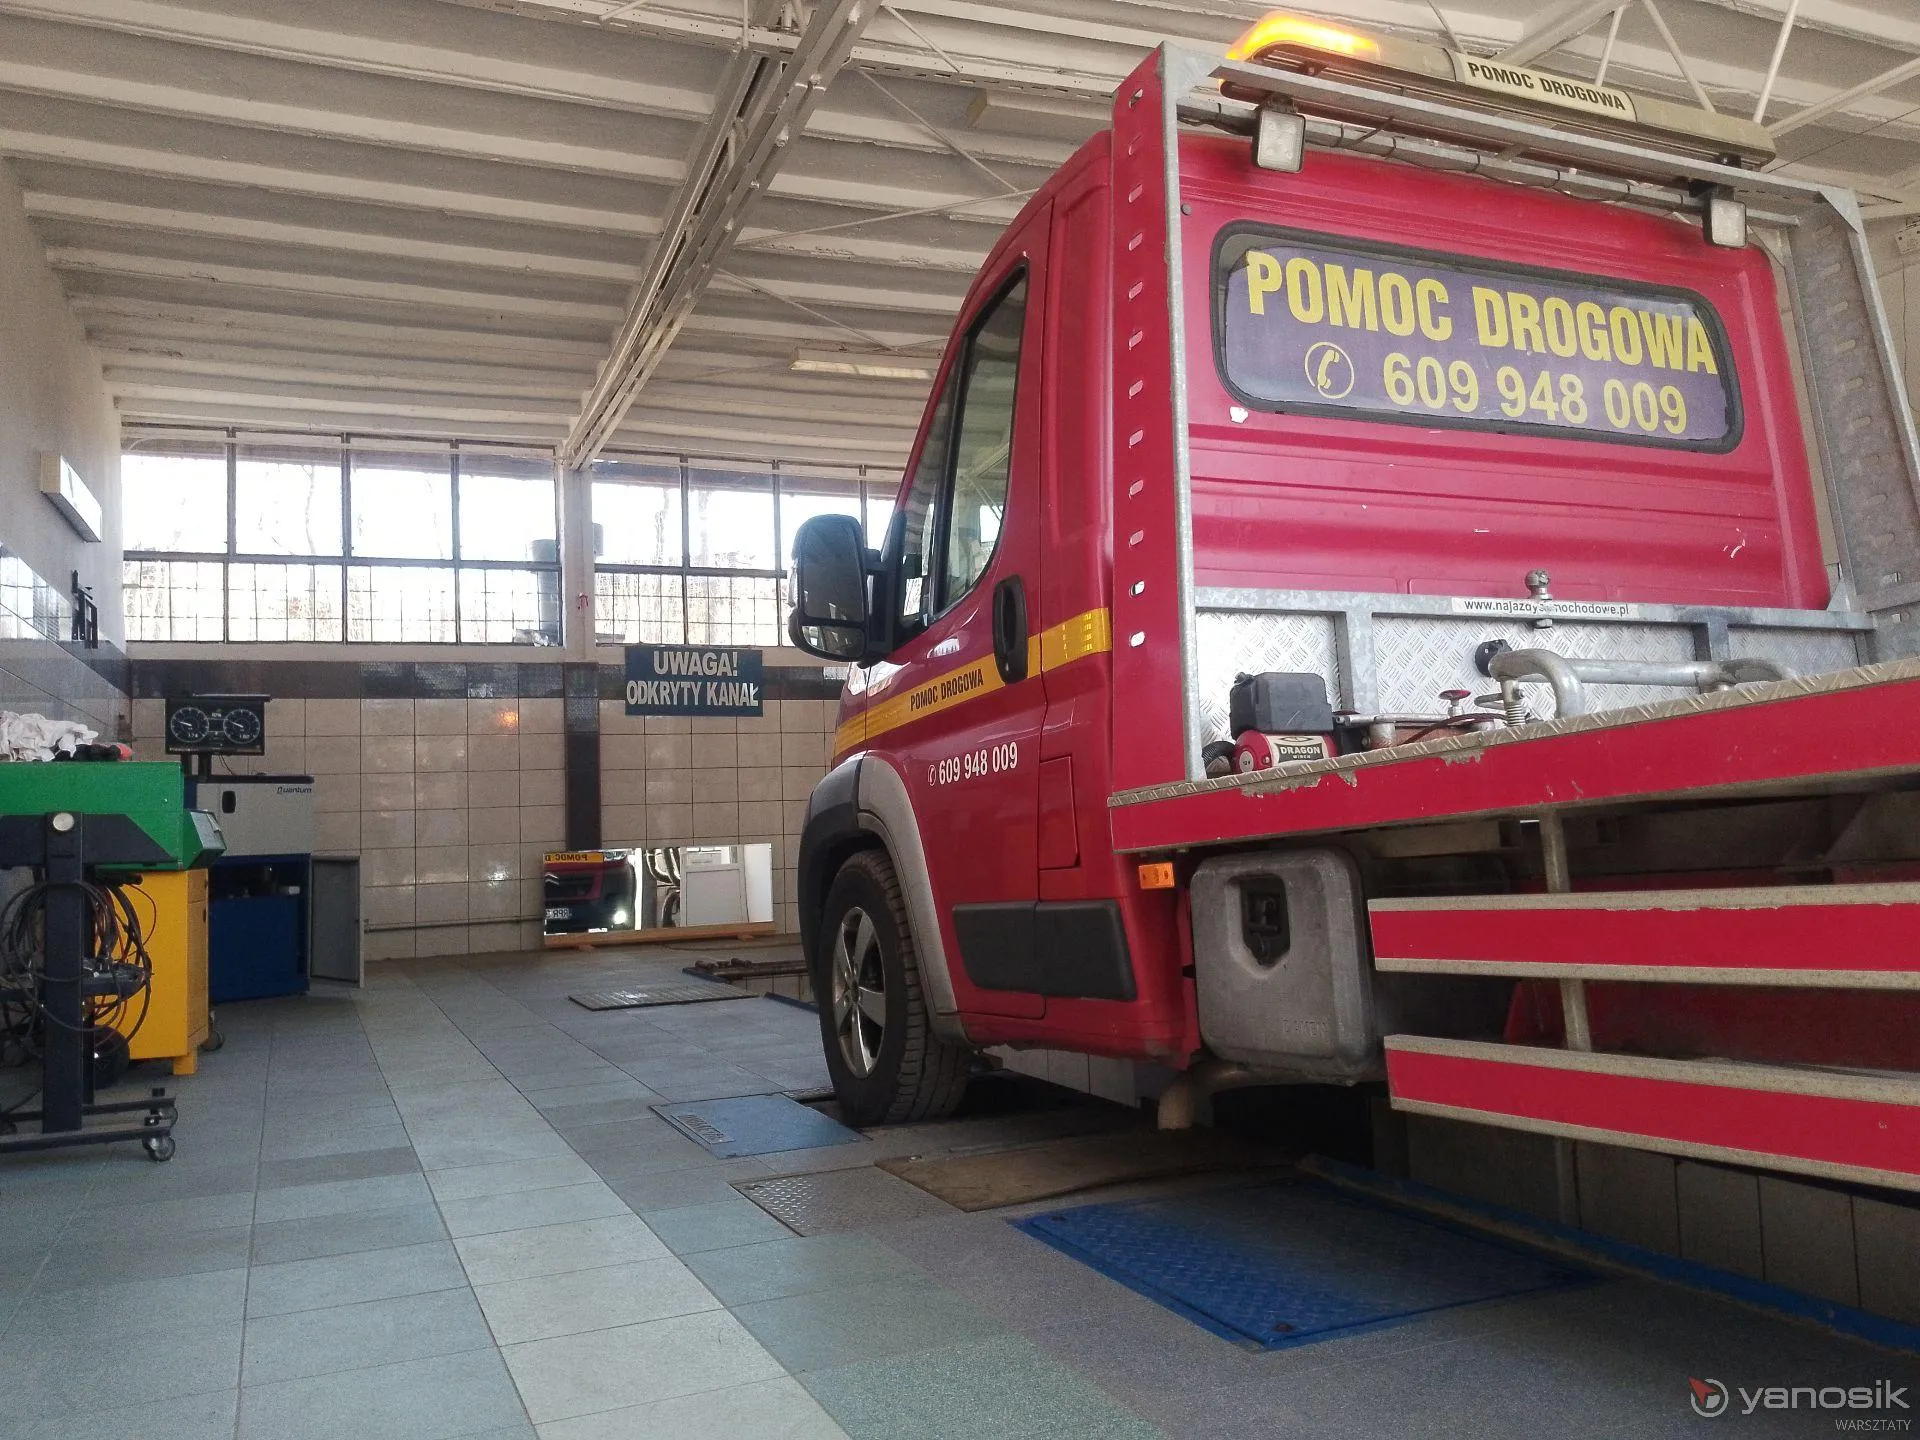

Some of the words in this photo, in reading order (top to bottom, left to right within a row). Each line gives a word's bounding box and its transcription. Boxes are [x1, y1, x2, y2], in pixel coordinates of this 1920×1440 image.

[1467, 61, 1535, 90] POMOC
[1538, 77, 1627, 111] DROGOWA
[1246, 250, 1454, 342] POMOC
[1471, 286, 1719, 376] DROGOWA
[1382, 352, 1480, 413] 609
[1496, 365, 1589, 424] 948
[1603, 378, 1688, 435] 009
[653, 650, 738, 677] UWAGA!
[626, 680, 702, 706] ODKRYTY
[706, 681, 759, 707] KANAŁ
[910, 685, 939, 712] POMOC
[941, 668, 984, 700] DROGOWA
[938, 756, 960, 785] 609
[964, 749, 988, 780] 948
[992, 741, 1018, 773] 009
[1280, 745, 1321, 755] DRAGON
